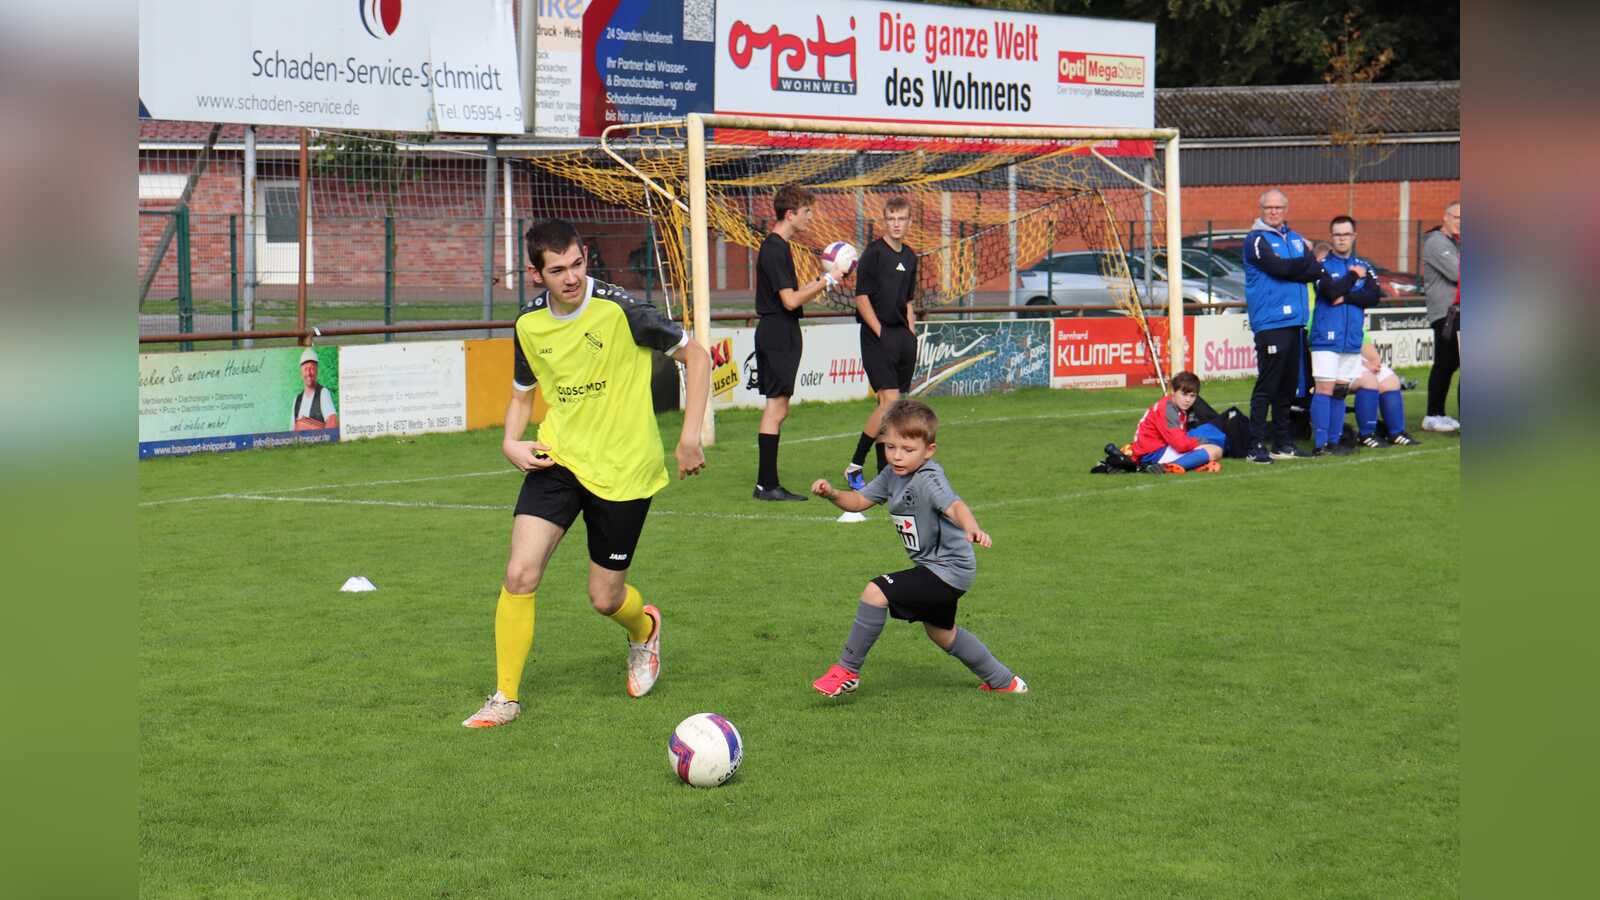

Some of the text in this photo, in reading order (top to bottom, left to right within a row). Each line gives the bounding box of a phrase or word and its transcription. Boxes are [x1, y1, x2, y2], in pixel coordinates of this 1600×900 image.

[606, 27, 615, 39] 24
[879, 11, 1039, 64] Die ganze Welt
[728, 14, 857, 90] opti
[252, 49, 502, 92] Schaden-Service-Schmidt
[618, 57, 644, 71] Partner
[645, 58, 656, 71] bei
[670, 83, 684, 92] von
[685, 81, 698, 92] der
[781, 78, 855, 95] WOHNWELT
[885, 68, 1032, 112] des Wohnens
[196, 93, 360, 117] www.schaden-service.de
[438, 103, 460, 120] Tel.
[463, 104, 501, 122] 05954
[605, 109, 617, 121] bis
[1057, 342, 1133, 368] KLUMPE
[169, 365, 184, 384] Sie
[187, 369, 220, 383] unseren
[801, 369, 825, 387] oder
[608, 552, 628, 561] JAKO
